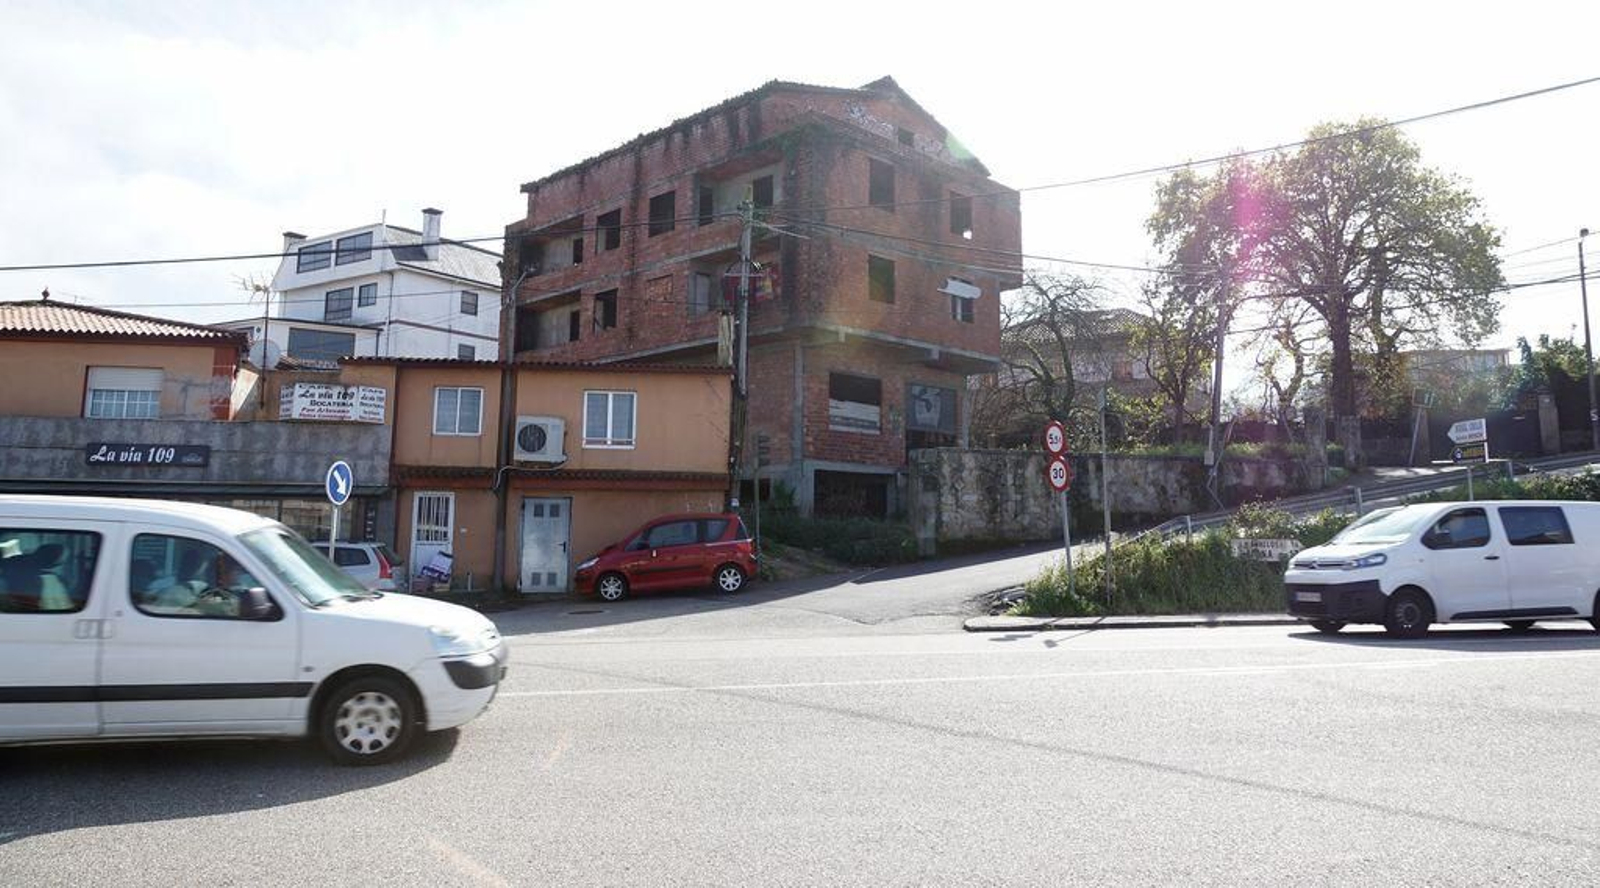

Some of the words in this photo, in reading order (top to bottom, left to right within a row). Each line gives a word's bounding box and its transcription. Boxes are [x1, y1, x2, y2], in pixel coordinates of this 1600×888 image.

[298, 390, 315, 398] La
[337, 391, 355, 400] 109
[90, 444, 115, 462] La
[147, 447, 175, 463] 109
[1053, 468, 1064, 478] 30
